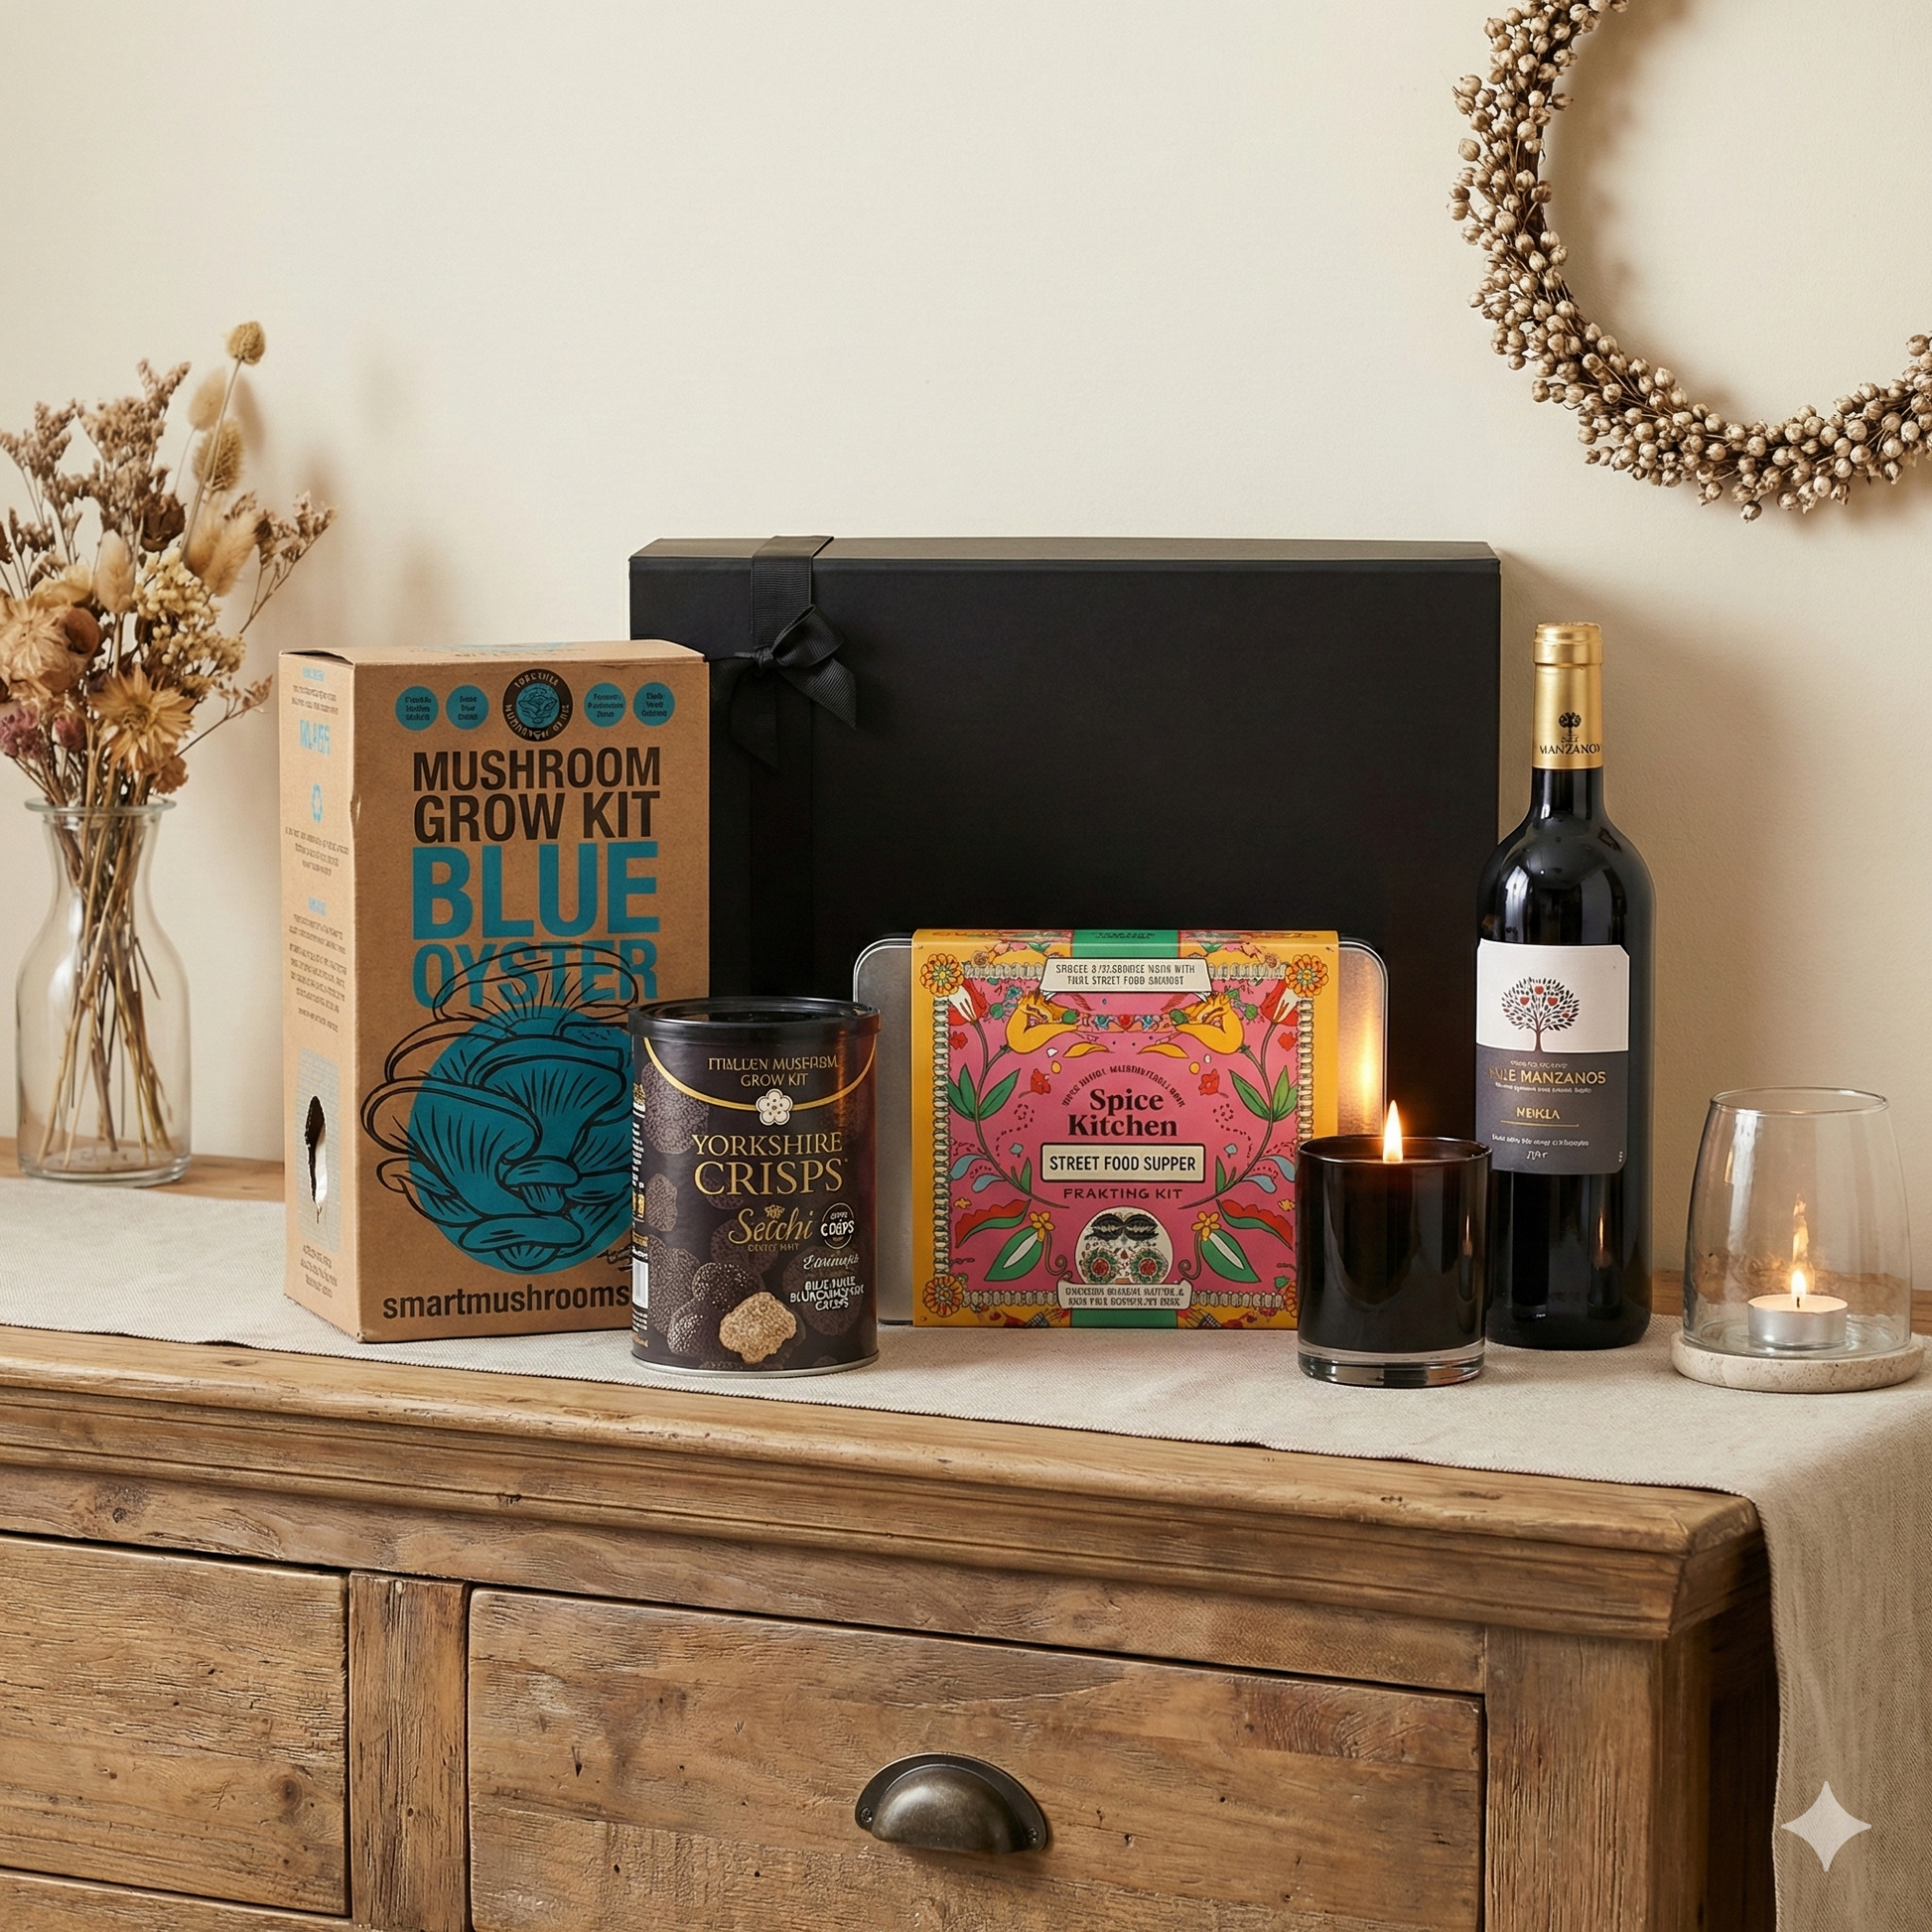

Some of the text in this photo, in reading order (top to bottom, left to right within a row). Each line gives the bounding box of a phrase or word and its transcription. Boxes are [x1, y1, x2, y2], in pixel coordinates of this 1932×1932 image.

[413, 747, 660, 791] MUSHROOM
[413, 790, 660, 843] GROW KIT
[412, 841, 660, 940] BLUE
[412, 938, 659, 1009] OYSTER
[1174, 964, 1195, 974] WITH
[741, 1072, 809, 1087] GROW KIT
[1520, 1069, 1606, 1085] MANZANOS
[1089, 1088, 1164, 1116] Spice
[1068, 1114, 1177, 1137] Kitchen
[691, 1132, 843, 1157] YORKSHIRE
[1049, 1156, 1196, 1172] STREET FOOD SUPPER
[694, 1159, 843, 1196] CRISPS
[1063, 1188, 1183, 1199] FRAKTING KIT
[382, 1284, 629, 1319] smartmushrooms
